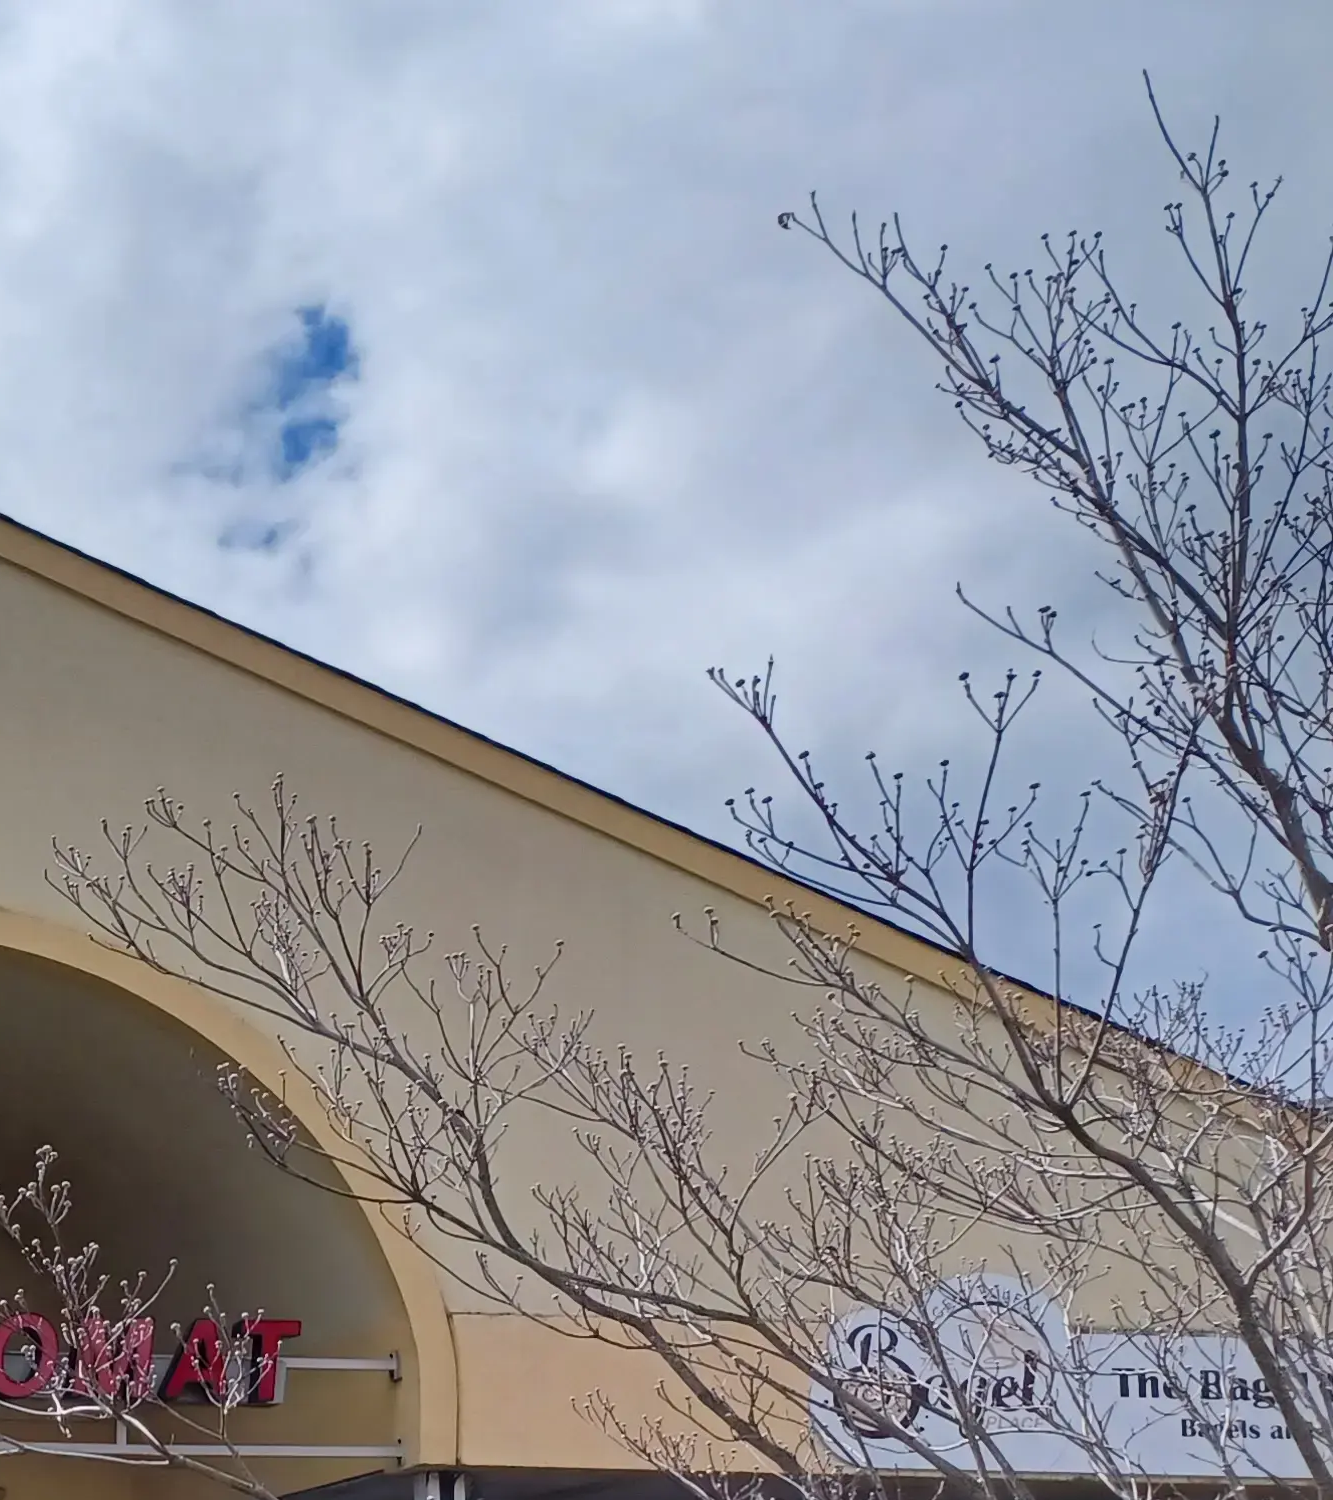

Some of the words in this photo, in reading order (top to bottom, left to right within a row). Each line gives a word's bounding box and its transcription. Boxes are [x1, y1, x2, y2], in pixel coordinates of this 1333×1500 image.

[1112, 1367, 1185, 1399] The
[1199, 1369, 1318, 1408] Bag
[1181, 1419, 1261, 1440] Bels
